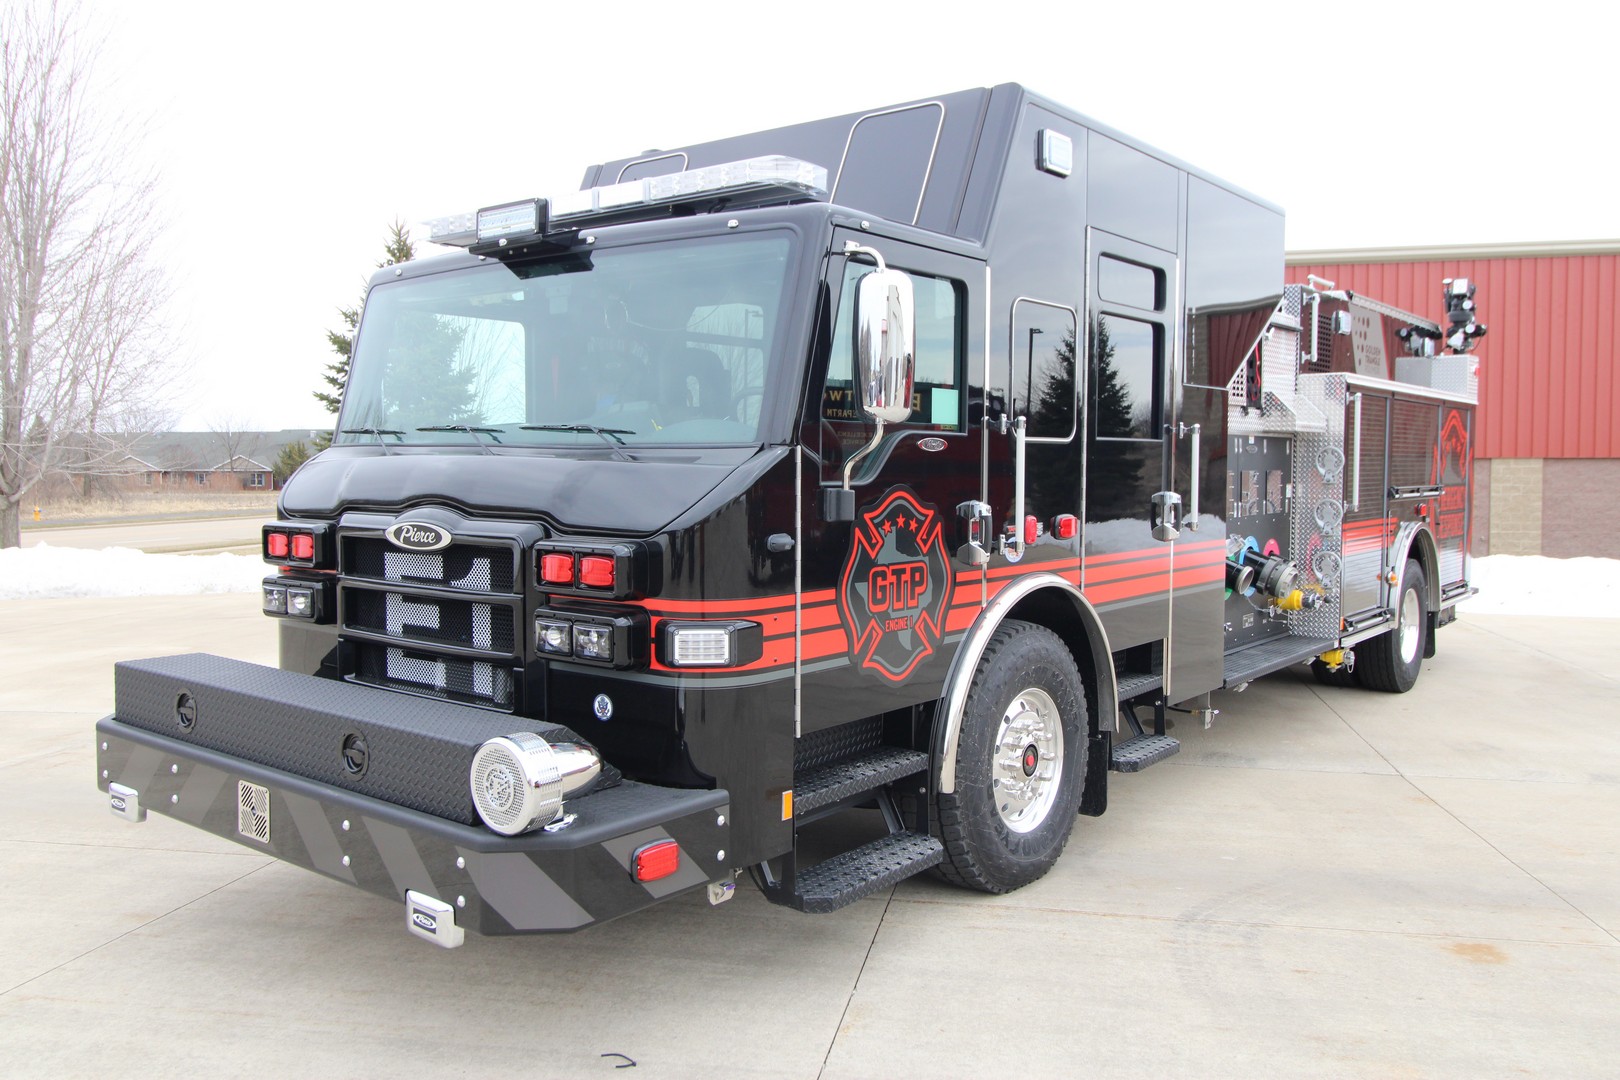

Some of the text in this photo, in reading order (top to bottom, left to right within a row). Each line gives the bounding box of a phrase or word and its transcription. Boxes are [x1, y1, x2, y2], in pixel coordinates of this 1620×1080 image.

[400, 525, 437, 544] Pierce
[868, 561, 928, 612] GTP
[384, 552, 493, 696] E1
[885, 616, 908, 632] ENGINE
